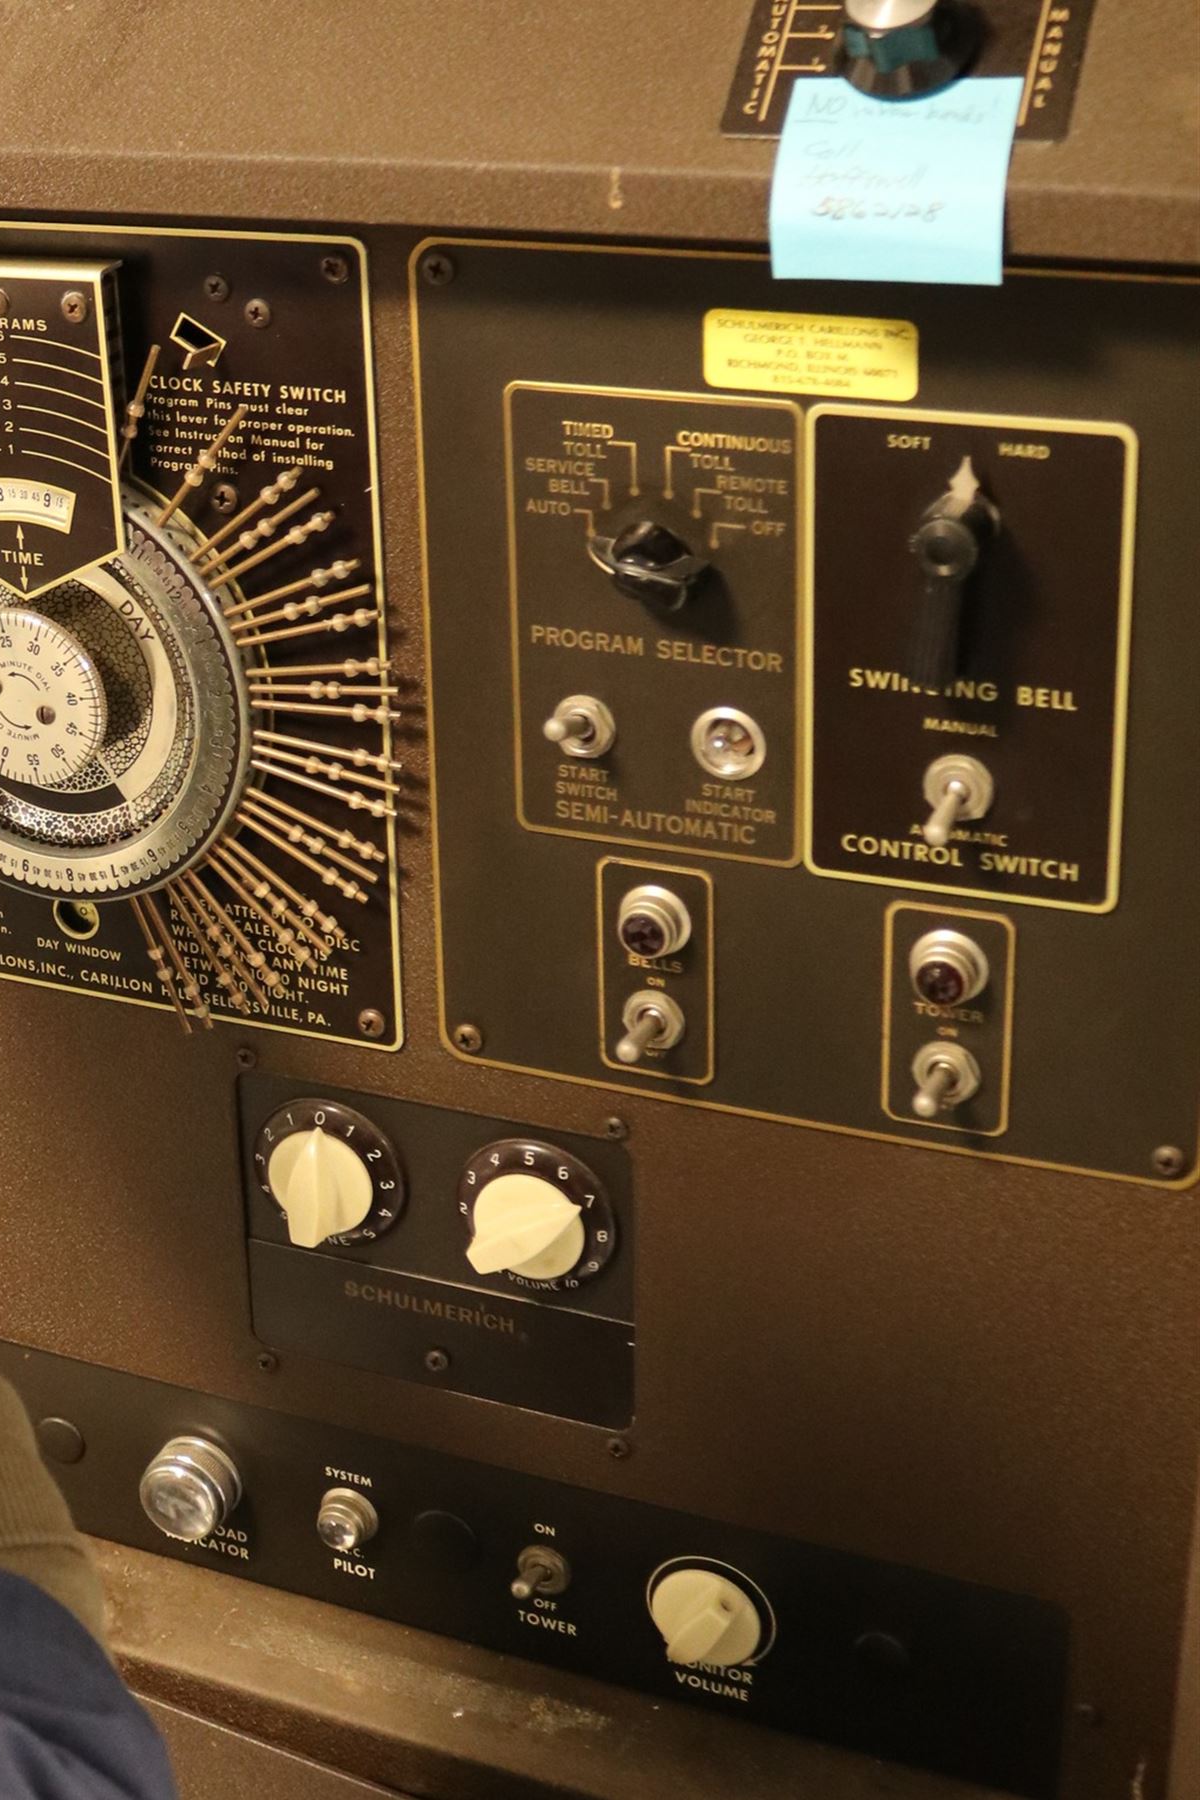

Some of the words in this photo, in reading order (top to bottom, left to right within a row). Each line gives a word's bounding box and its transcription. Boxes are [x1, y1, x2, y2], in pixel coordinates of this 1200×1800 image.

[743, 0, 788, 114] UTOMATIC
[149, 375, 203, 393] CLOCK
[212, 380, 271, 398] SAFETY
[279, 385, 347, 404] SWITCH
[146, 393, 198, 408] Program
[206, 397, 232, 411] Pins
[275, 403, 309, 417] clear
[147, 409, 171, 422] this
[176, 411, 208, 425] lever
[239, 418, 283, 431] proper
[287, 421, 355, 437] operation.
[562, 420, 614, 440] TIMED
[251, 433, 300, 449] Manual
[306, 437, 324, 451] for
[563, 441, 607, 460] TOLL
[676, 430, 792, 454] CONTINUOUS
[886, 434, 932, 450] SOFT
[998, 442, 1051, 460] HARD
[252, 449, 266, 462] of
[272, 451, 334, 471] installing
[525, 457, 596, 477] SERVICE
[689, 453, 736, 472] TOLL
[549, 479, 590, 496] BELL
[715, 475, 788, 495] REMOTE
[526, 499, 571, 516] AUTO
[722, 496, 768, 514] TOLL
[750, 520, 787, 537] OFF
[1, 549, 44, 566] TIME
[119, 600, 155, 640] DAY
[0, 635, 13, 648] 25
[26, 640, 41, 656] 30
[50, 661, 66, 677] 35
[530, 624, 644, 656] PROGRAM
[656, 639, 784, 673] SELECTOR
[1016, 685, 1078, 711] BELL
[922, 716, 999, 738] MANUAL
[1, 746, 9, 758] 0
[558, 764, 610, 783] START
[555, 781, 618, 801] SWITCH
[701, 783, 755, 802] START
[685, 798, 777, 824] INDICATOR
[555, 800, 756, 845] SEMI-AUTOMATIC
[840, 833, 964, 867] CONTROL
[979, 852, 1080, 882] SWITCH
[37, 937, 59, 950] DAY
[65, 941, 122, 962] WINDOW
[324, 934, 360, 952] DISC
[272, 956, 304, 972] ANY
[298, 976, 349, 996] NIGHT
[80, 969, 153, 993] CARILLON
[307, 1011, 332, 1027] PA.
[315, 1111, 325, 1125] 0
[367, 1149, 382, 1162] 2
[490, 1153, 500, 1167] 4
[524, 1151, 535, 1165] 5
[557, 1166, 569, 1180] 6
[380, 1180, 395, 1190] 3
[584, 1194, 595, 1208] 7
[596, 1230, 608, 1243] 8
[588, 1261, 599, 1272] 9
[508, 1271, 561, 1291] VOLUME
[344, 1280, 515, 1334] SCHULMERICH
[325, 1466, 372, 1487] SYSTEM
[534, 1523, 555, 1537] ON
[333, 1557, 376, 1580] PILOT
[533, 1598, 557, 1611] OFF
[518, 1609, 577, 1637] TOWER
[675, 1671, 749, 1702] VOLUME
